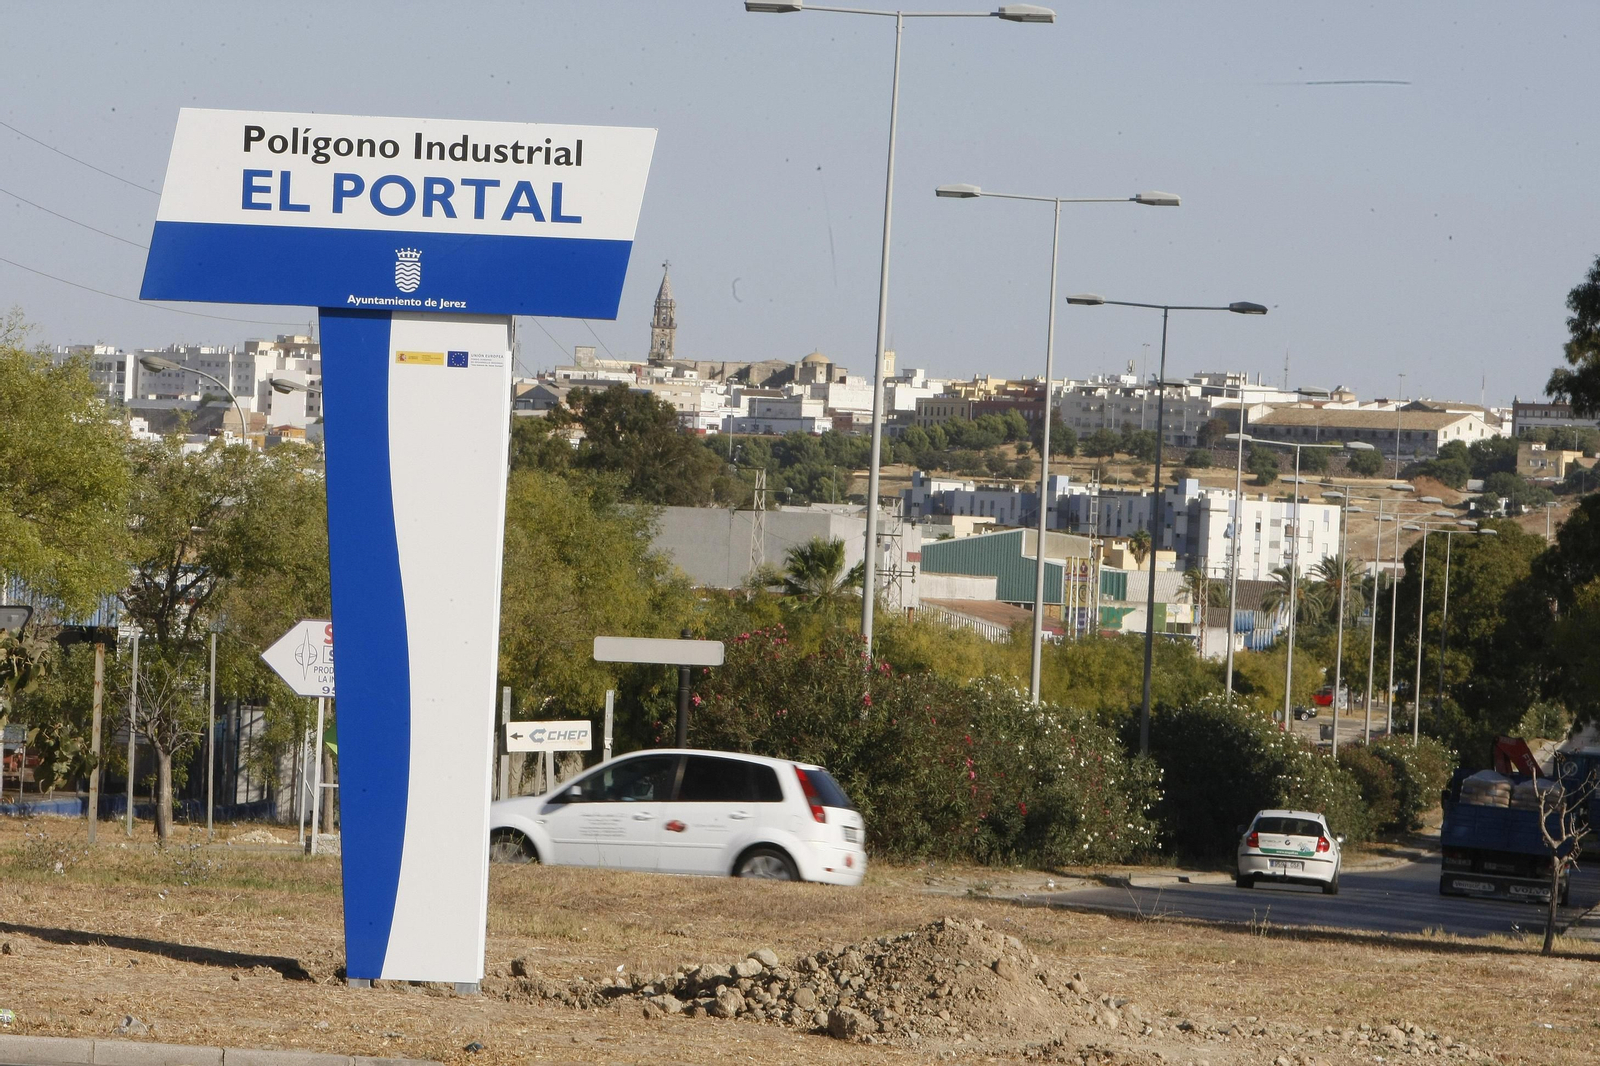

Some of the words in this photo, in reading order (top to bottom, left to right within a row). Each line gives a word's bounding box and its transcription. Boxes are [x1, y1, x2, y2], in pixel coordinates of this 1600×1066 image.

[242, 125, 401, 165] Polígono
[414, 132, 584, 168] Industrial
[241, 168, 311, 214] EL
[332, 172, 584, 225] PORTAL
[347, 294, 422, 307] Ayuntamiento
[424, 297, 437, 307] de
[438, 298, 467, 310] Jerez
[547, 730, 588, 741] CHEP
[1514, 886, 1551, 897] VOLVO
